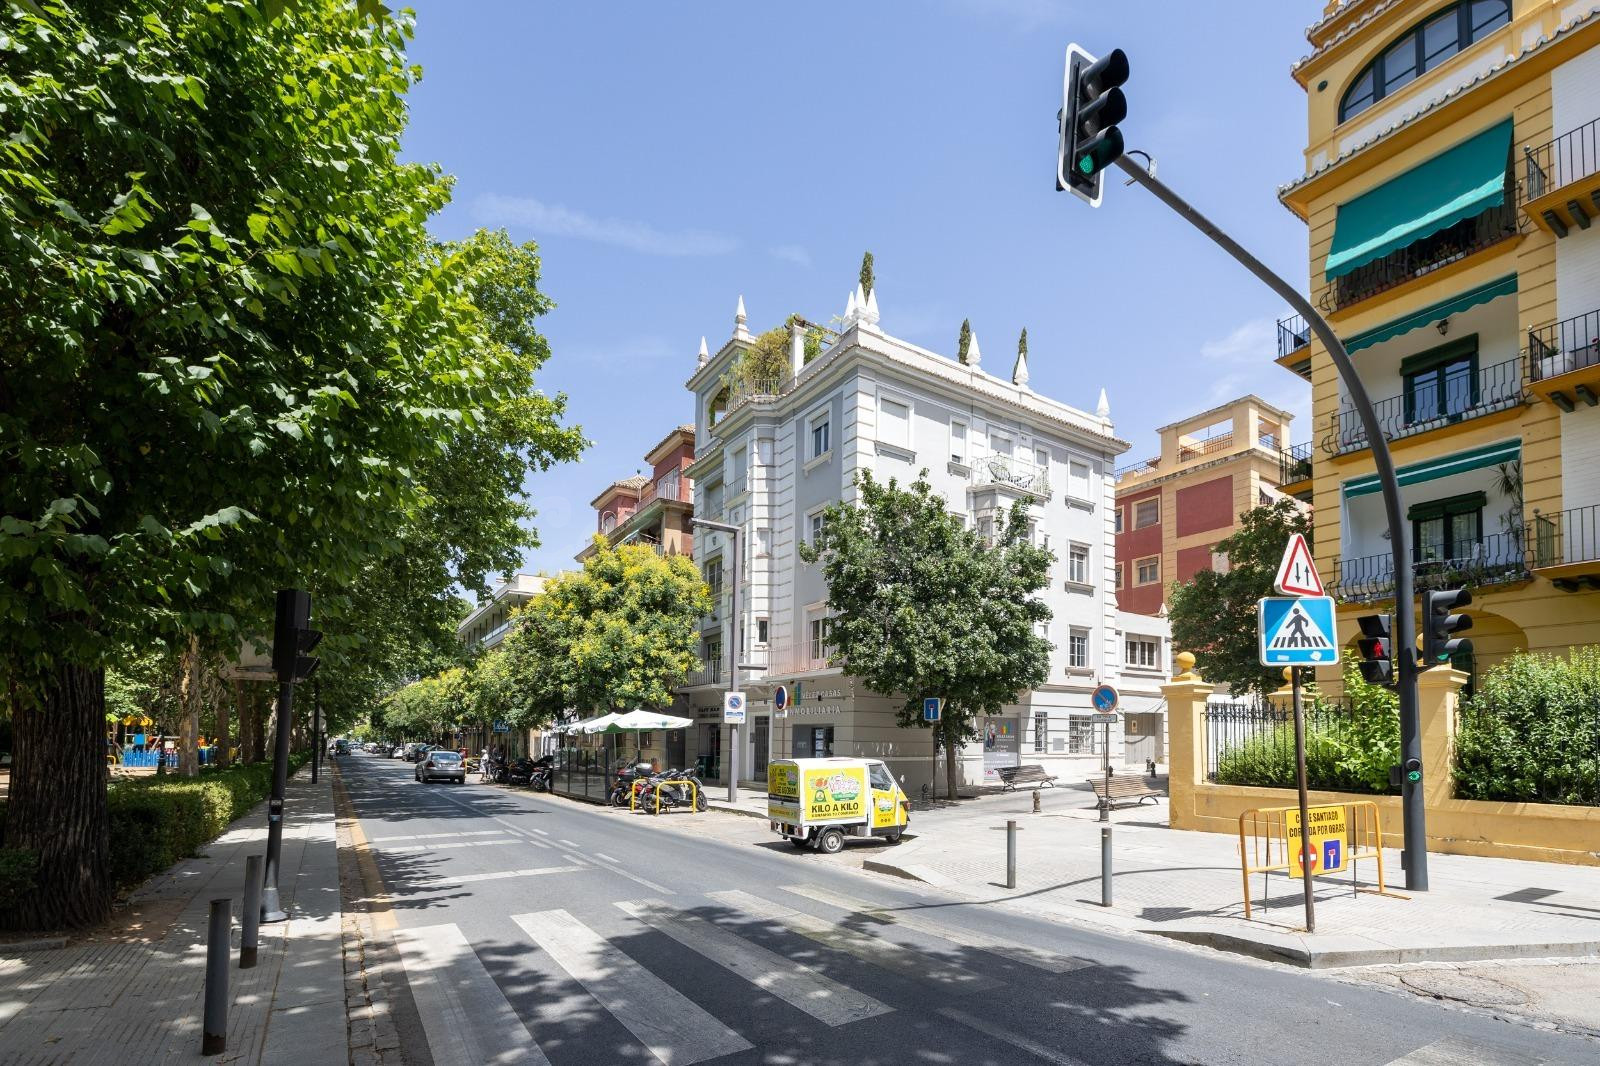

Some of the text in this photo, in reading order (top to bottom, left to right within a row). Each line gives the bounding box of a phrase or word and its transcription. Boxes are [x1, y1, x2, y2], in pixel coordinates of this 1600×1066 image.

[811, 802, 859, 813] KILO A KILO
[1312, 811, 1339, 822] SANTIAGO
[1317, 825, 1328, 835] POR
[1328, 823, 1345, 834] OBRAS
